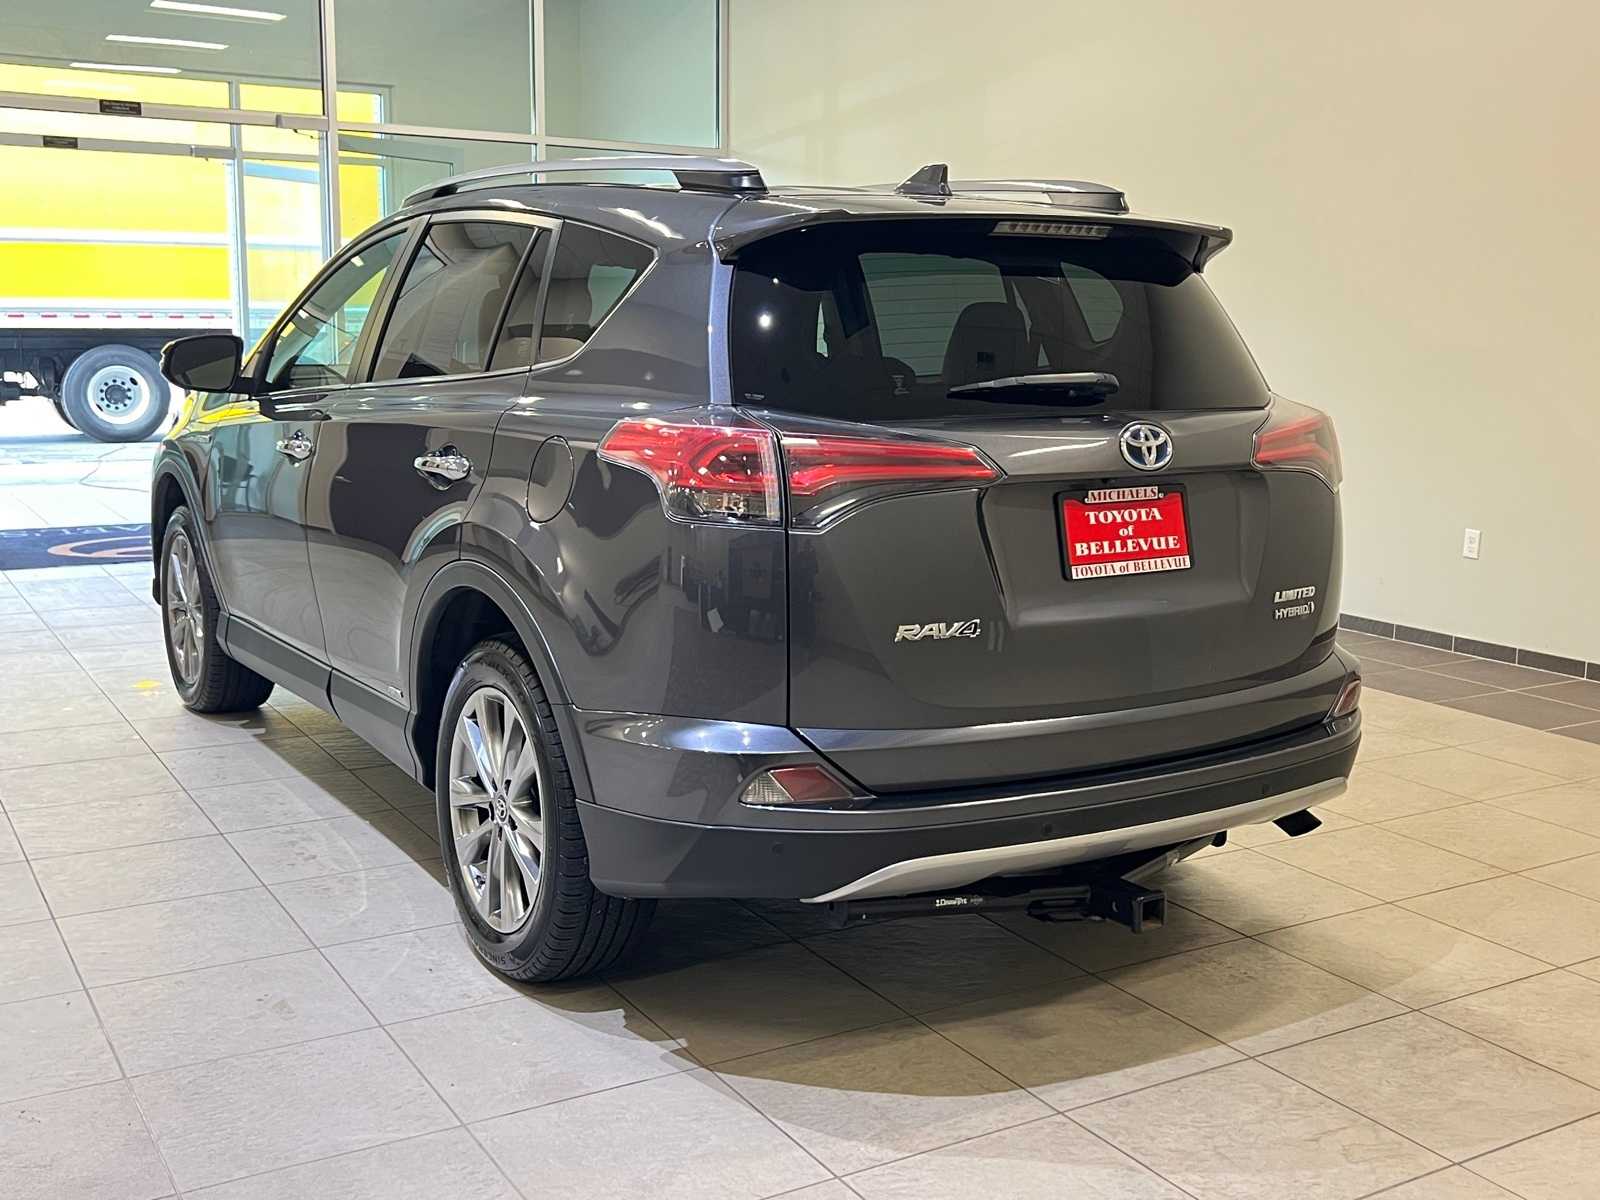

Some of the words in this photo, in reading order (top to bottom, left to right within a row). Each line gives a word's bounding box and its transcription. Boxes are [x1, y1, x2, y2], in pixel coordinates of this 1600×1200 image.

[1090, 487, 1157, 502] MICHAELS
[1085, 508, 1162, 525] TOYOTA
[1119, 525, 1135, 537] of
[1075, 535, 1180, 557] BELLEVUE
[1073, 563, 1117, 578] TOYOTA
[1119, 562, 1131, 574] of
[1133, 556, 1190, 573] BELLEVUE
[1274, 585, 1316, 604] LIMITED
[1275, 604, 1310, 620] HYBRID
[894, 618, 981, 643] RAV4
